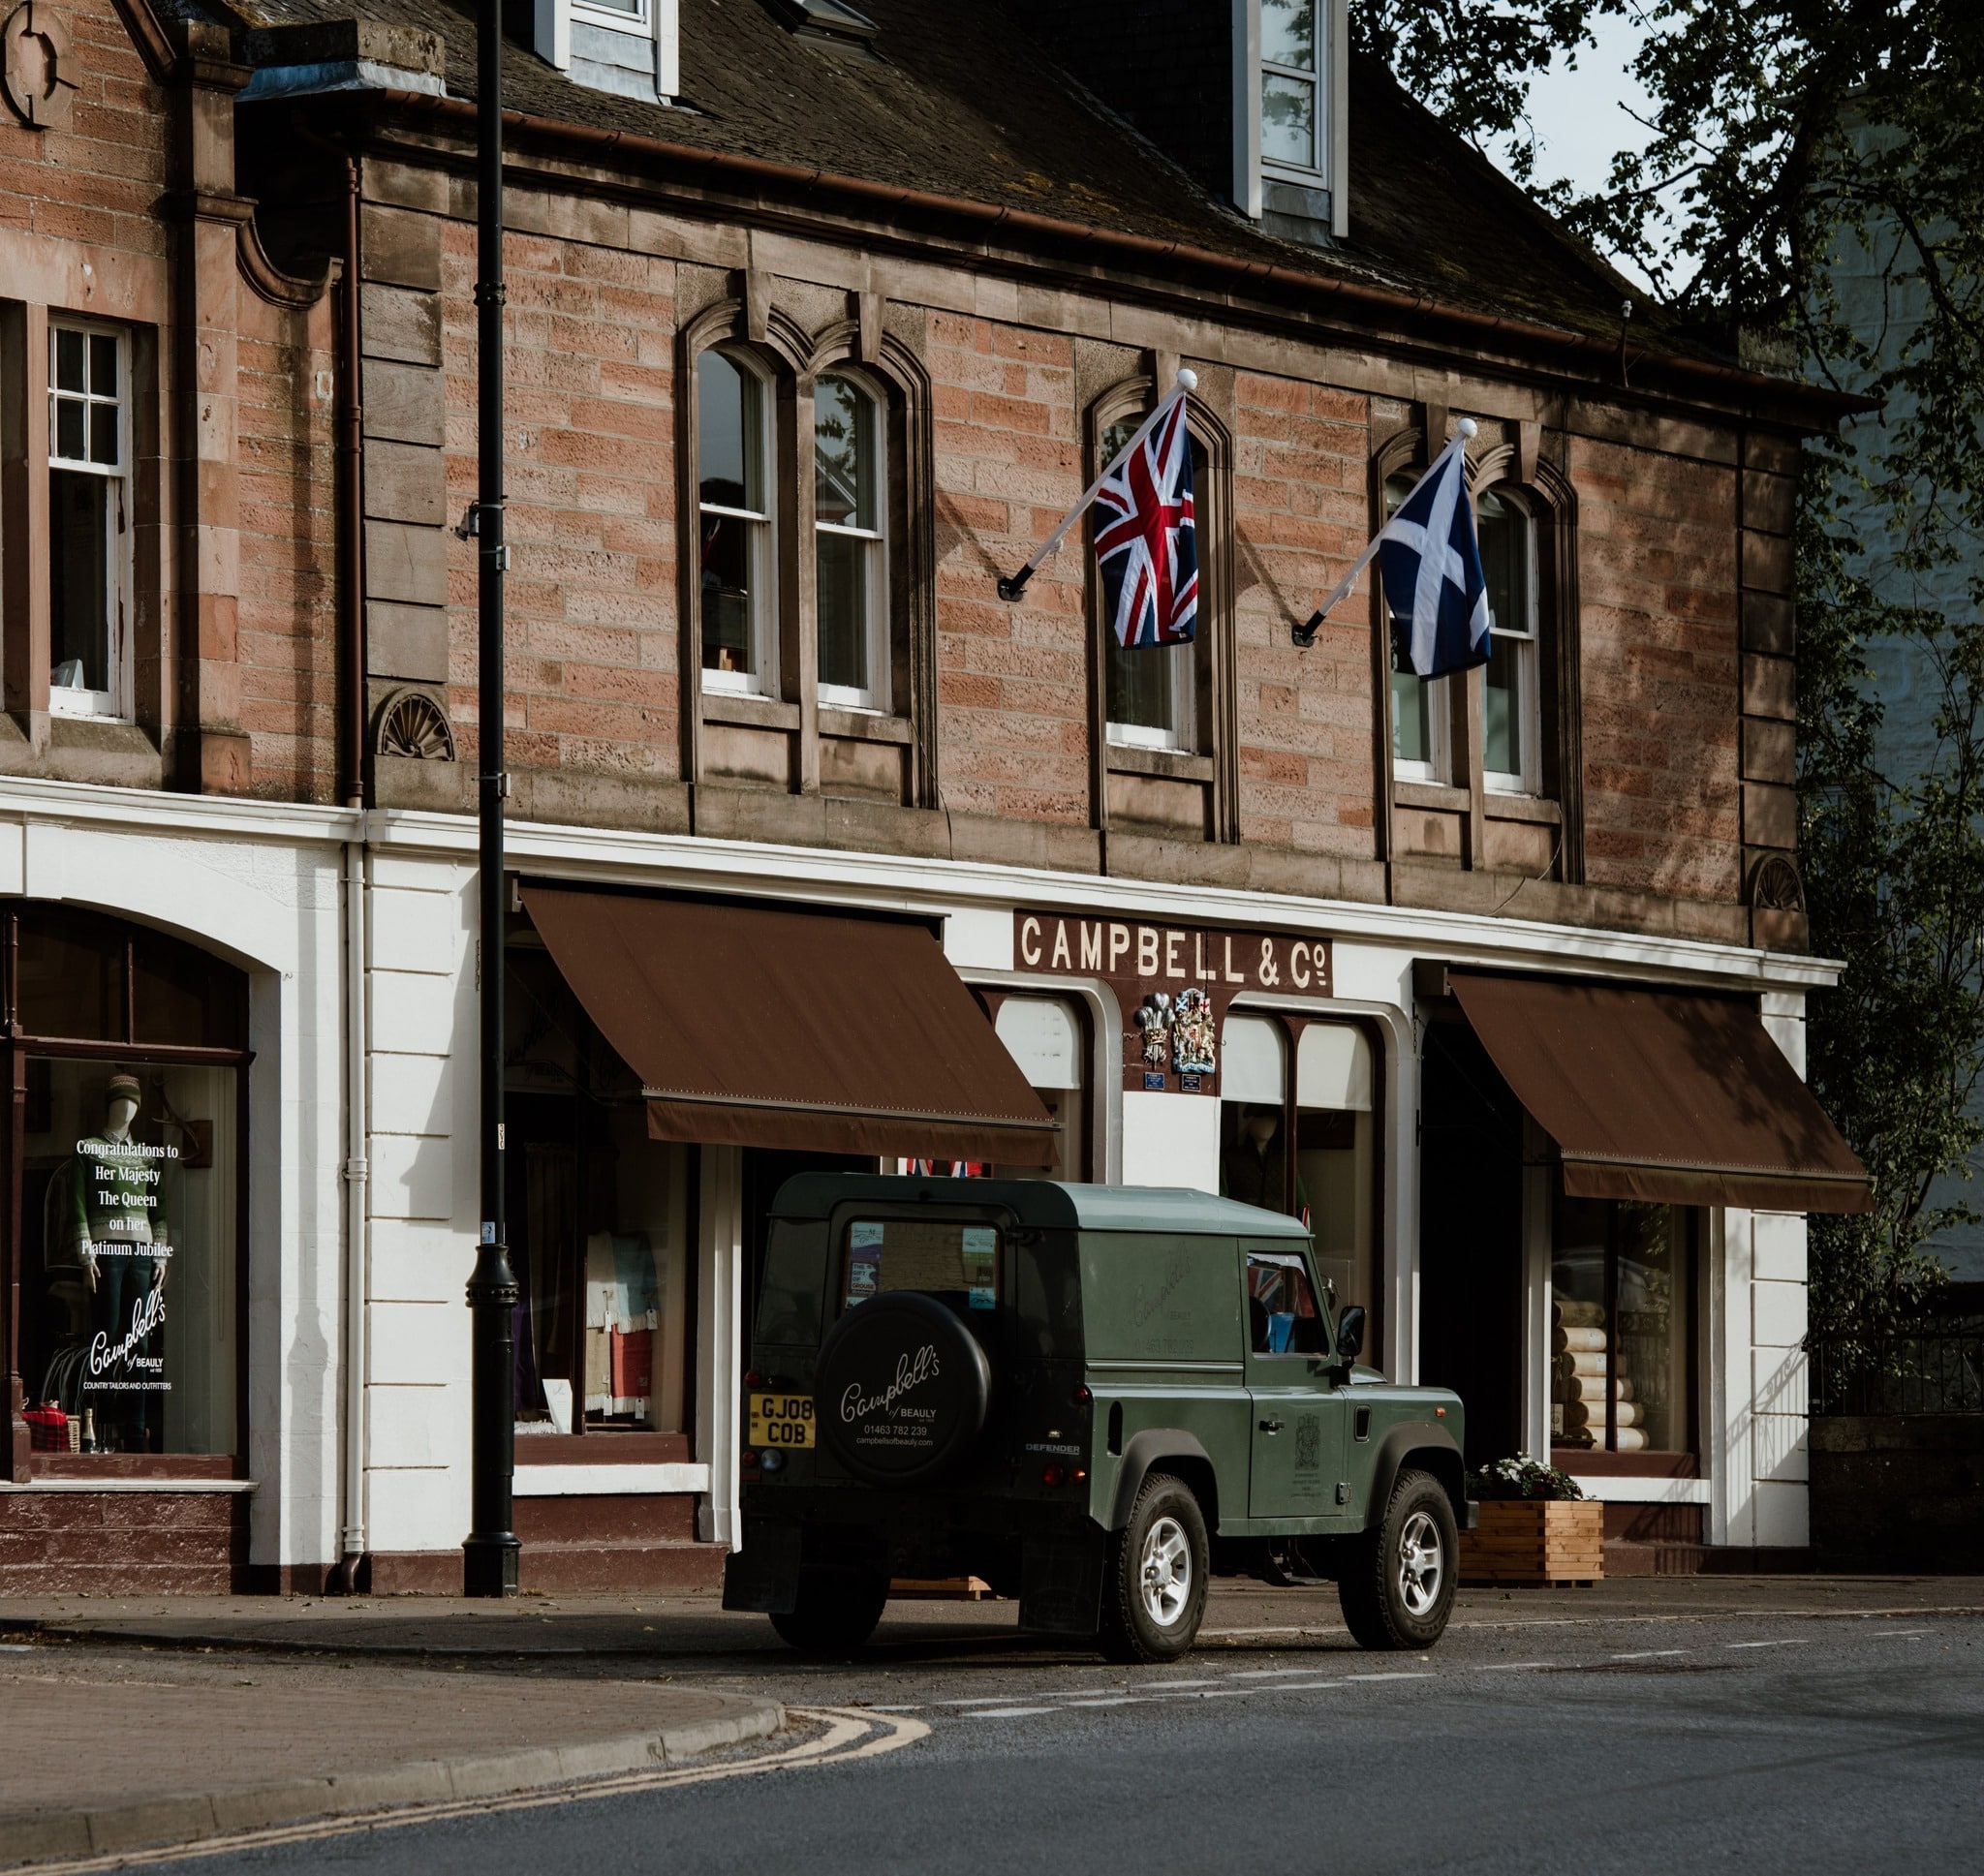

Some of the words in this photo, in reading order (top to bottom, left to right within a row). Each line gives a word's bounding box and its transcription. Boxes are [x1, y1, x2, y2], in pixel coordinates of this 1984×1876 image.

[1021, 916, 1244, 983] CAMPBELL
[1258, 937, 1280, 987] &
[76, 1139, 165, 1159] Congratulations
[166, 1144, 178, 1159] to
[95, 1165, 116, 1181] Her
[118, 1166, 160, 1185] Majesty
[98, 1190, 119, 1206] The
[121, 1191, 157, 1208] Queen
[108, 1218, 125, 1231] on
[126, 1217, 146, 1232] her
[81, 1240, 132, 1256] Platinum
[134, 1241, 173, 1257] Jubilee
[90, 1288, 166, 1375] Campbell's
[136, 1357, 164, 1368] BEAULY
[83, 1381, 108, 1390] COUNTRY
[108, 1381, 130, 1390] TAILORS
[141, 1382, 171, 1391] OUTFITTERS
[840, 1344, 940, 1423] Campbell's
[762, 1398, 813, 1421] GJ08
[901, 1408, 937, 1418] BEAULY
[767, 1422, 806, 1444] COB
[863, 1425, 890, 1435] 01463
[892, 1426, 909, 1435] 782
[911, 1426, 927, 1436] 239
[855, 1436, 933, 1448] campbellsofbeauly.com
[1025, 1443, 1081, 1454] DEFENDER
